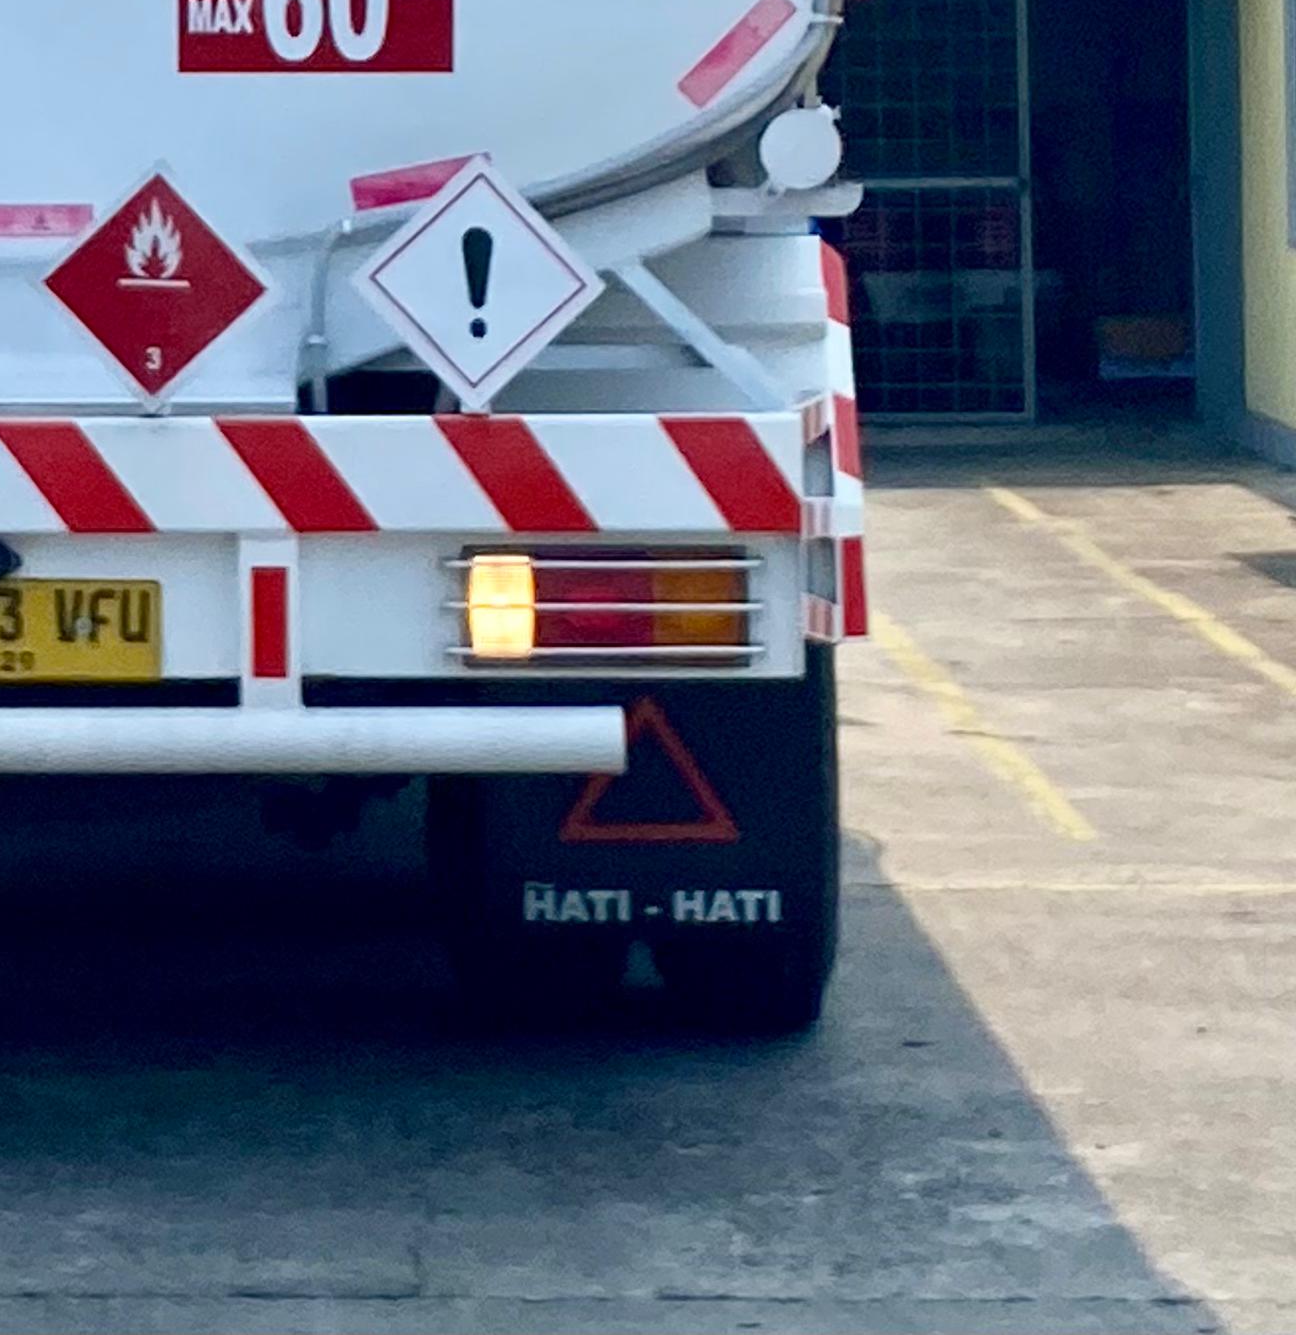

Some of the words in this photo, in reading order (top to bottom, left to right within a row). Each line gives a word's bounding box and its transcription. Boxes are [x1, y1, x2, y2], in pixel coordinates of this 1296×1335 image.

[145, 347, 162, 368] 3
[524, 881, 632, 922] HATI
[672, 889, 781, 923] HATI
